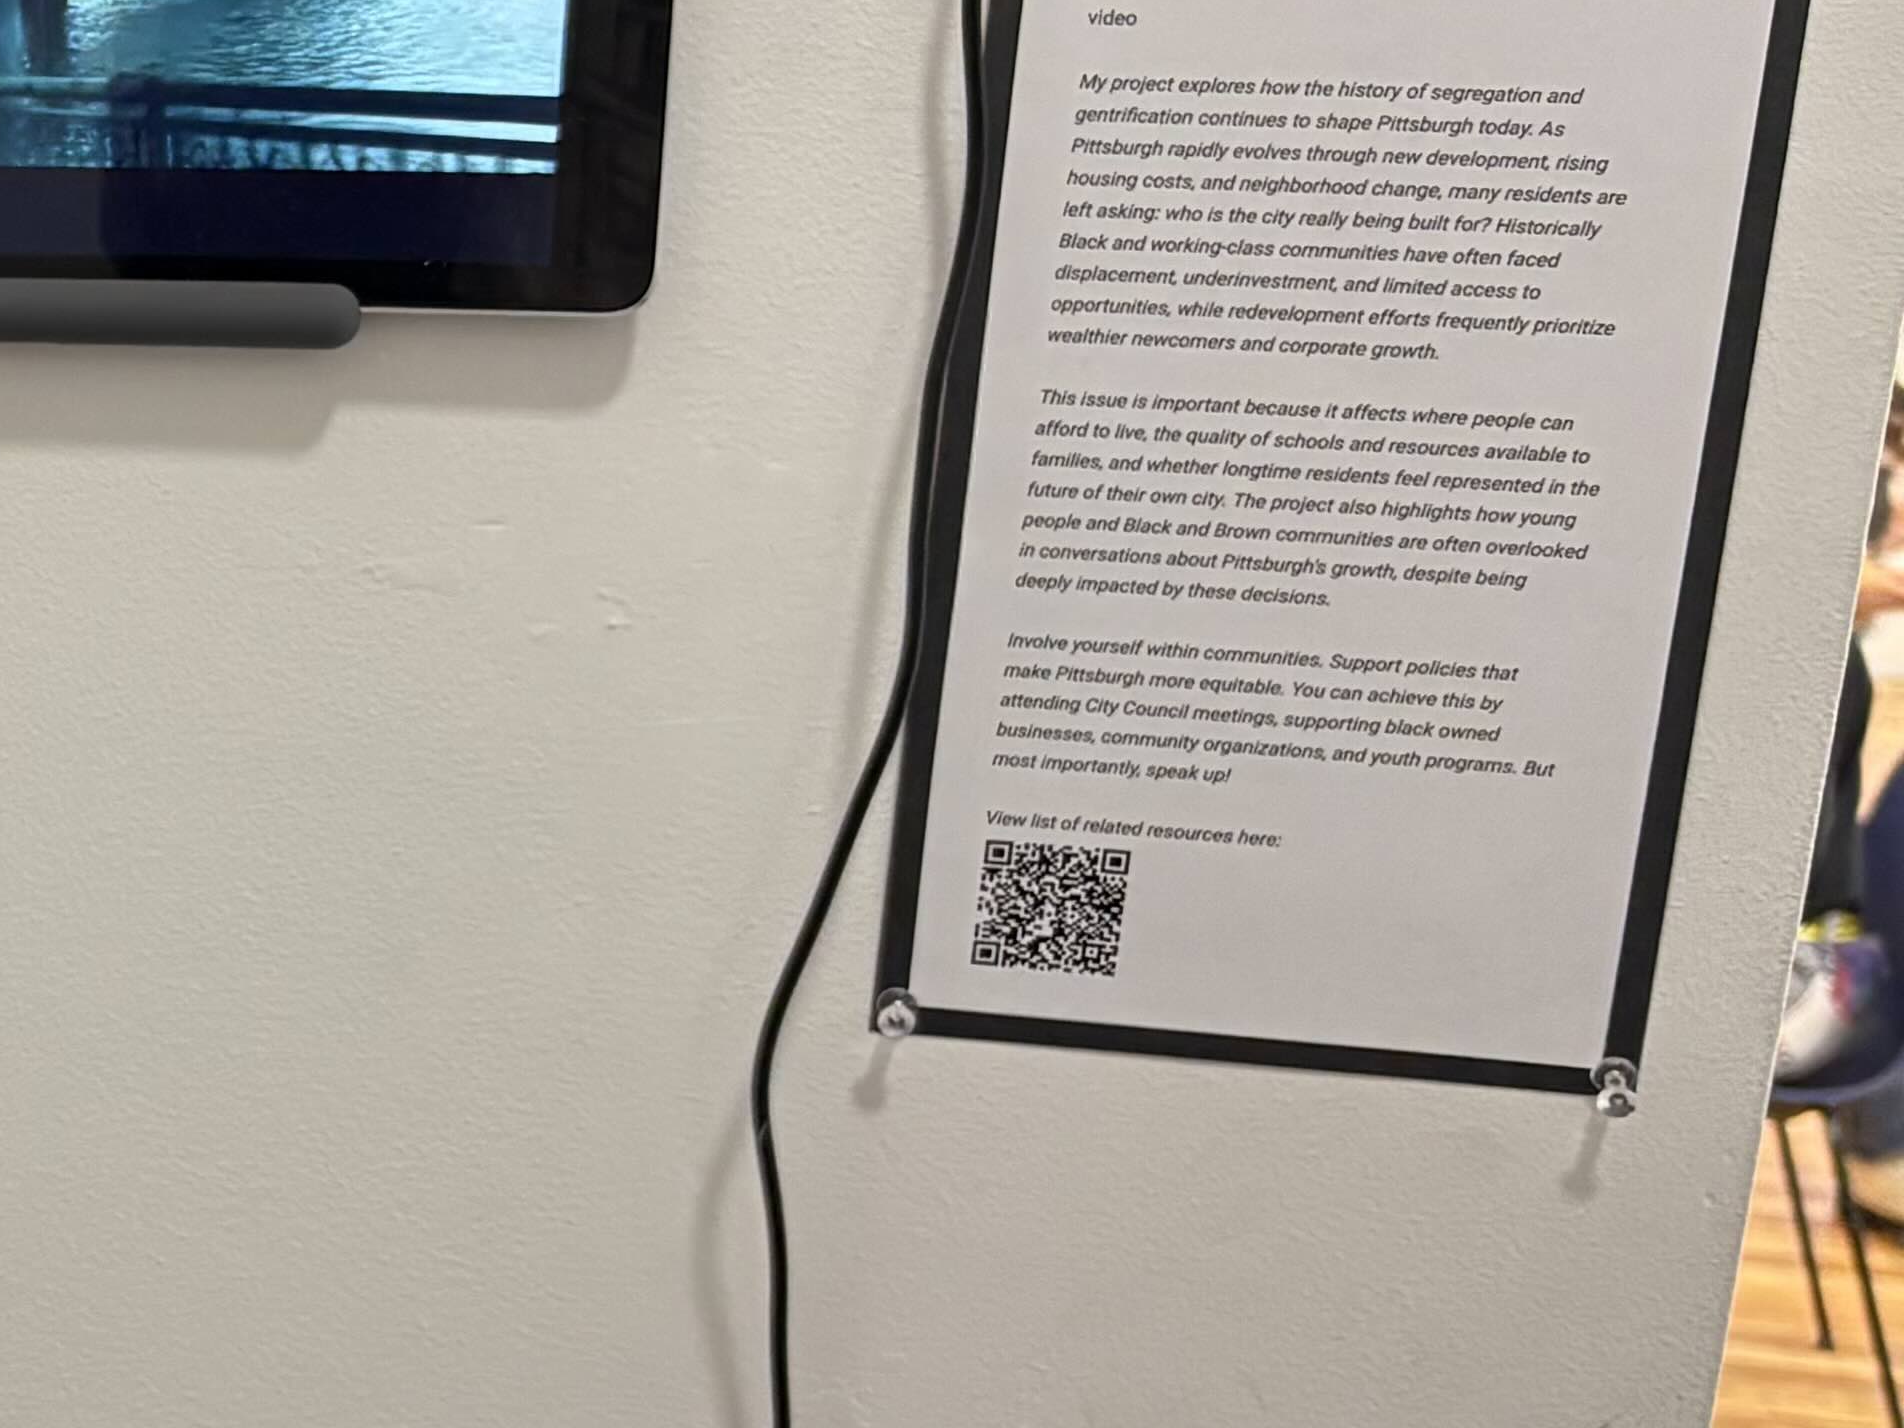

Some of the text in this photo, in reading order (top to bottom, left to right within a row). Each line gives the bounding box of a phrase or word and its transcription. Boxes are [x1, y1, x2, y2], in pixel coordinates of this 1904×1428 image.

[1087, 8, 1138, 27] video
[1079, 73, 1586, 106] My project explores how the history of segregation and
[1073, 106, 1566, 141] gentrification continues to shape Pittsburgh today. As
[1070, 137, 1610, 176] Pittsburgh rapidly evolves through new development, rising
[1066, 168, 1628, 206] housing costs, and neighborhood change, many residents are
[1062, 200, 1603, 242] left asking: who is the city really being built for? Historically
[1058, 232, 1563, 269] Black and working-class communities have often faced
[1054, 263, 1542, 301] displacement, underinvestment, and limited access to
[1050, 298, 1617, 337] opportunities, while redevelopment efforts frequently prioritize
[1047, 327, 1440, 361] wealthier newcomers and corporate growth.
[1041, 388, 1575, 432] This issue is important because it affects where people can
[1034, 419, 1591, 465] afford to live, the quality of schools and resources available to
[1031, 449, 1601, 497] families, and whether longtime residents feel represented in the
[1020, 513, 1590, 560] people and Black and Brown communities are often overlooked
[1018, 542, 1529, 592] in conversations about Pittsburgh's growth, despite being
[1007, 632, 1520, 682] Involve yourself within communities. Support policies that
[1003, 663, 1504, 715] make Pittsburgh more equitable. You can achieve this by
[991, 753, 1233, 785] most importantly, speak up!
[986, 810, 1282, 848] View list of related resources here:
